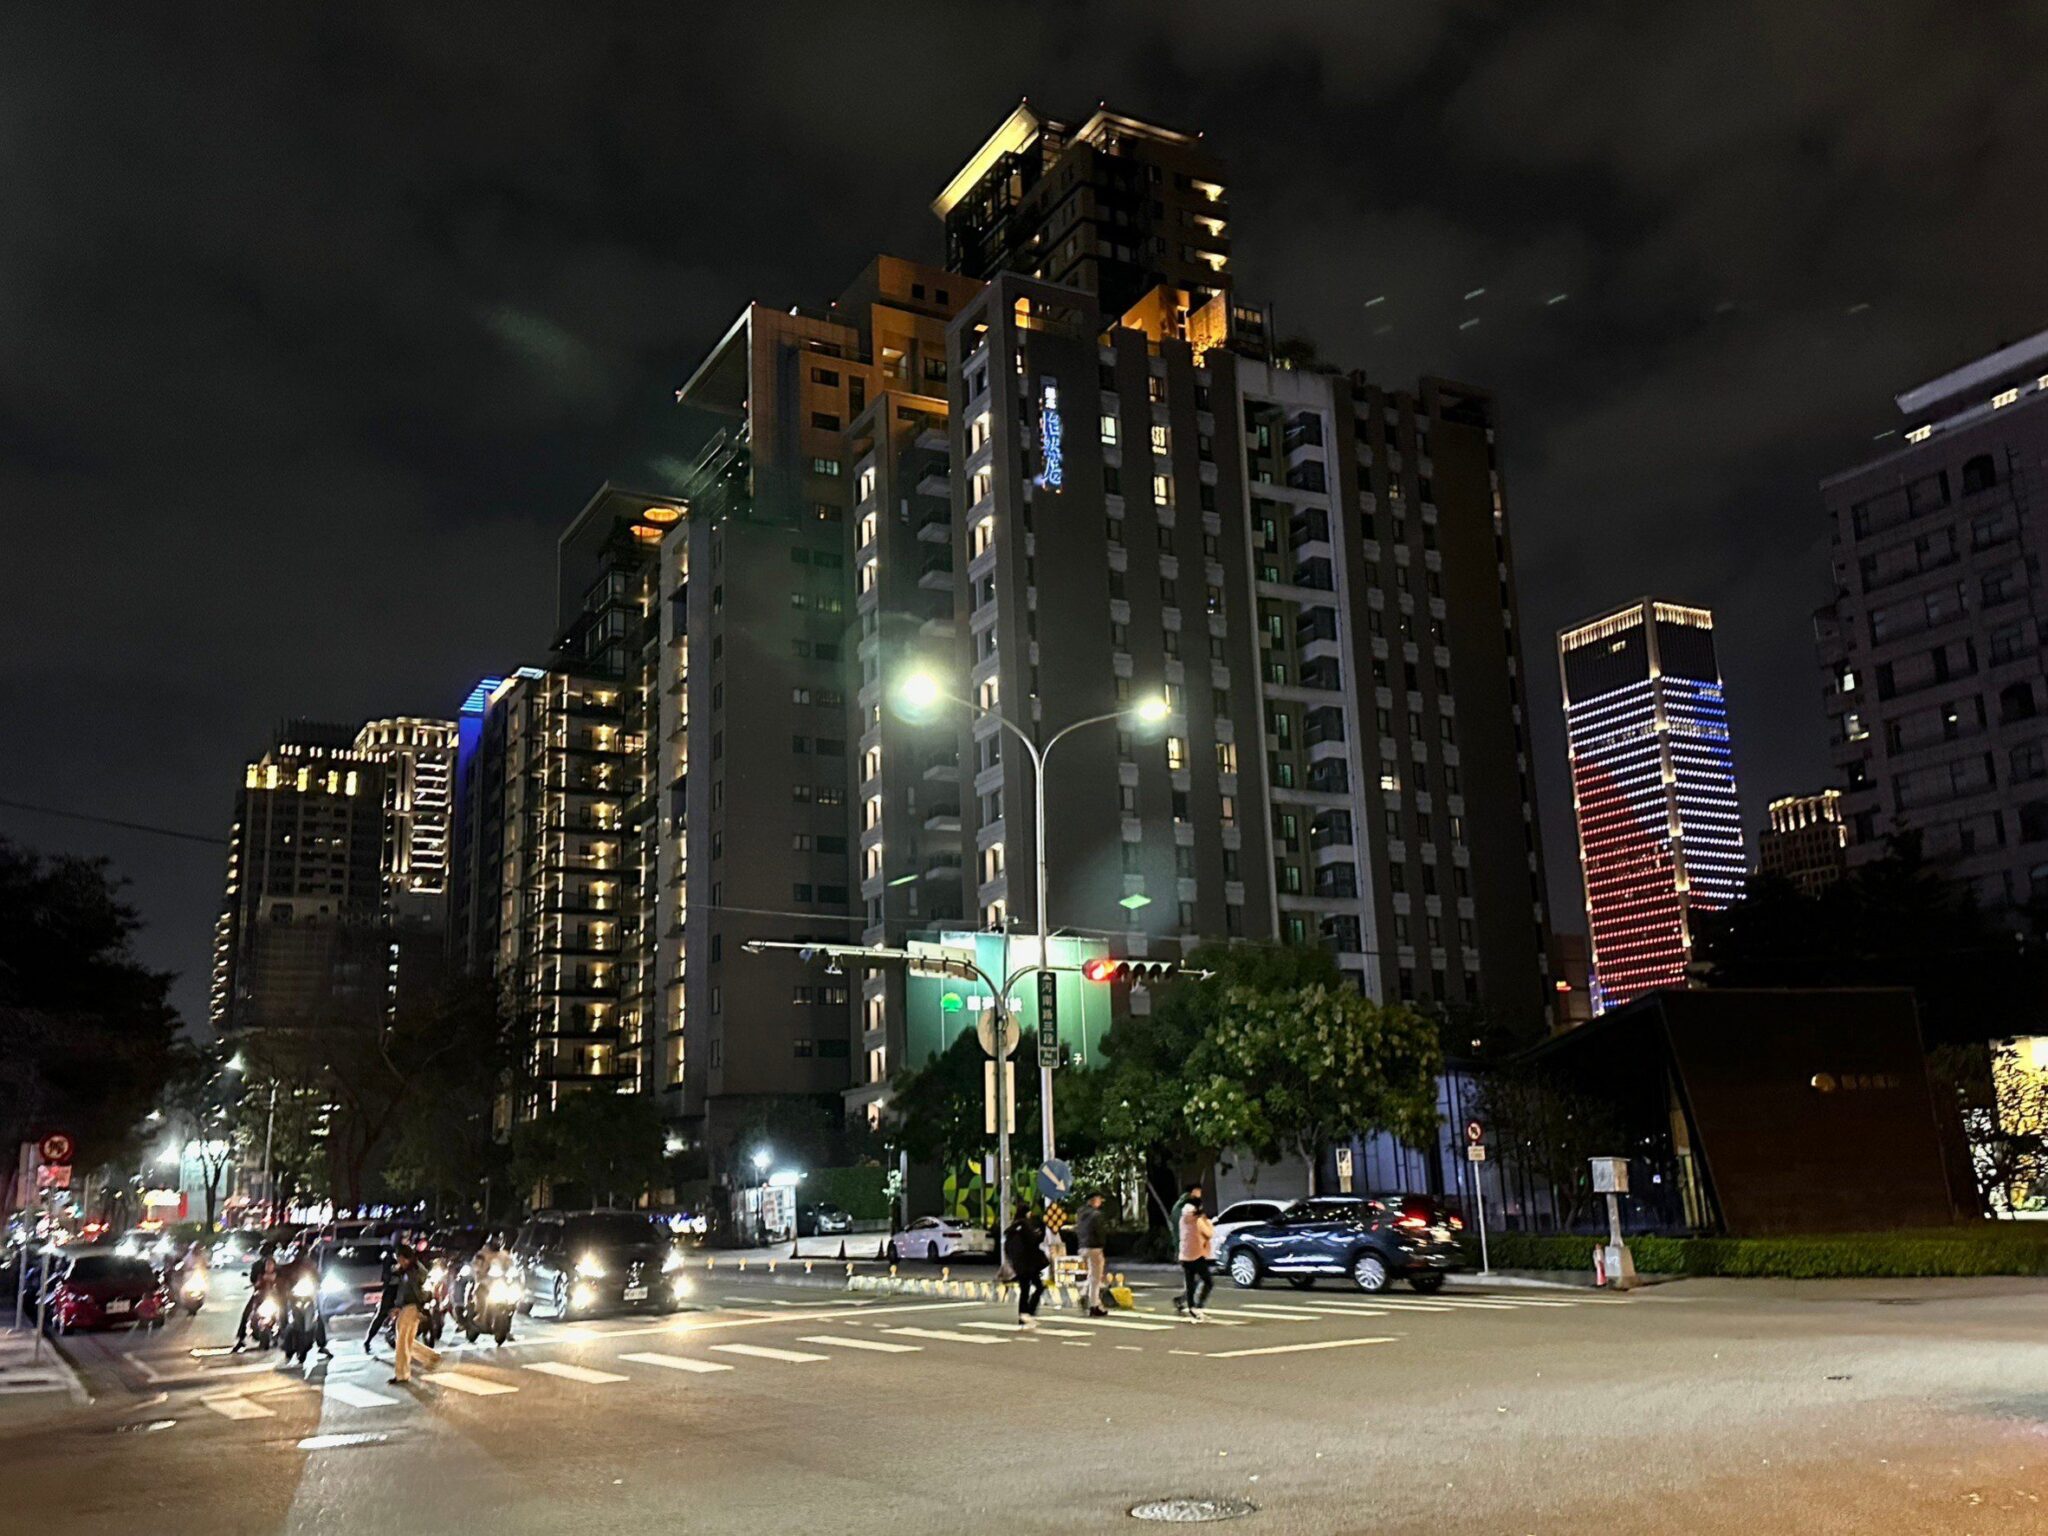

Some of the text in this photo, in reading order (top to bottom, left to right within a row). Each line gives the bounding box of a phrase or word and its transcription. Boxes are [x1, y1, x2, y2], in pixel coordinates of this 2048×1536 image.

[1042, 981, 1053, 1044] 河南路三段
